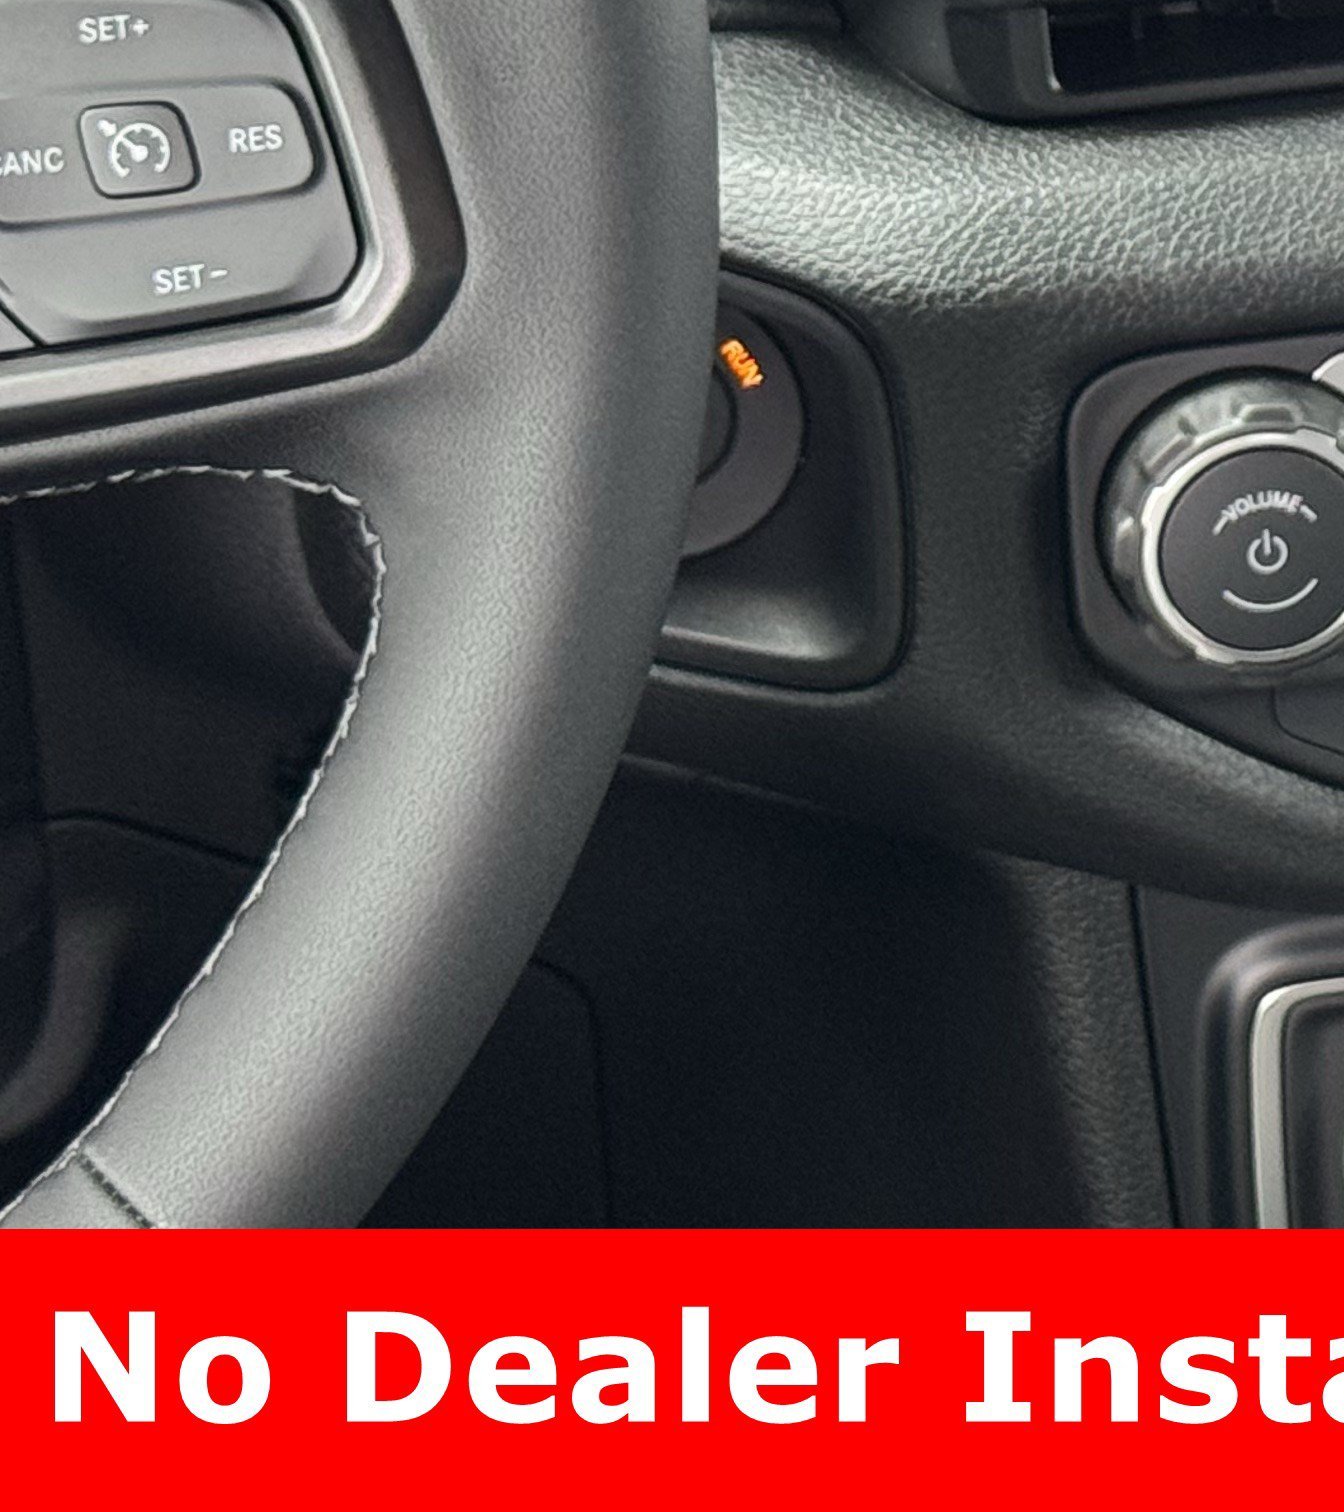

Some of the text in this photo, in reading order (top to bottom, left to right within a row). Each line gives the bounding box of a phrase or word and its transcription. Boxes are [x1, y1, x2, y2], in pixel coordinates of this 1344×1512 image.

[77, 12, 151, 45] SET+
[227, 123, 284, 155] RES
[718, 337, 764, 389] RUN
[1221, 488, 1304, 523] VOLUME
